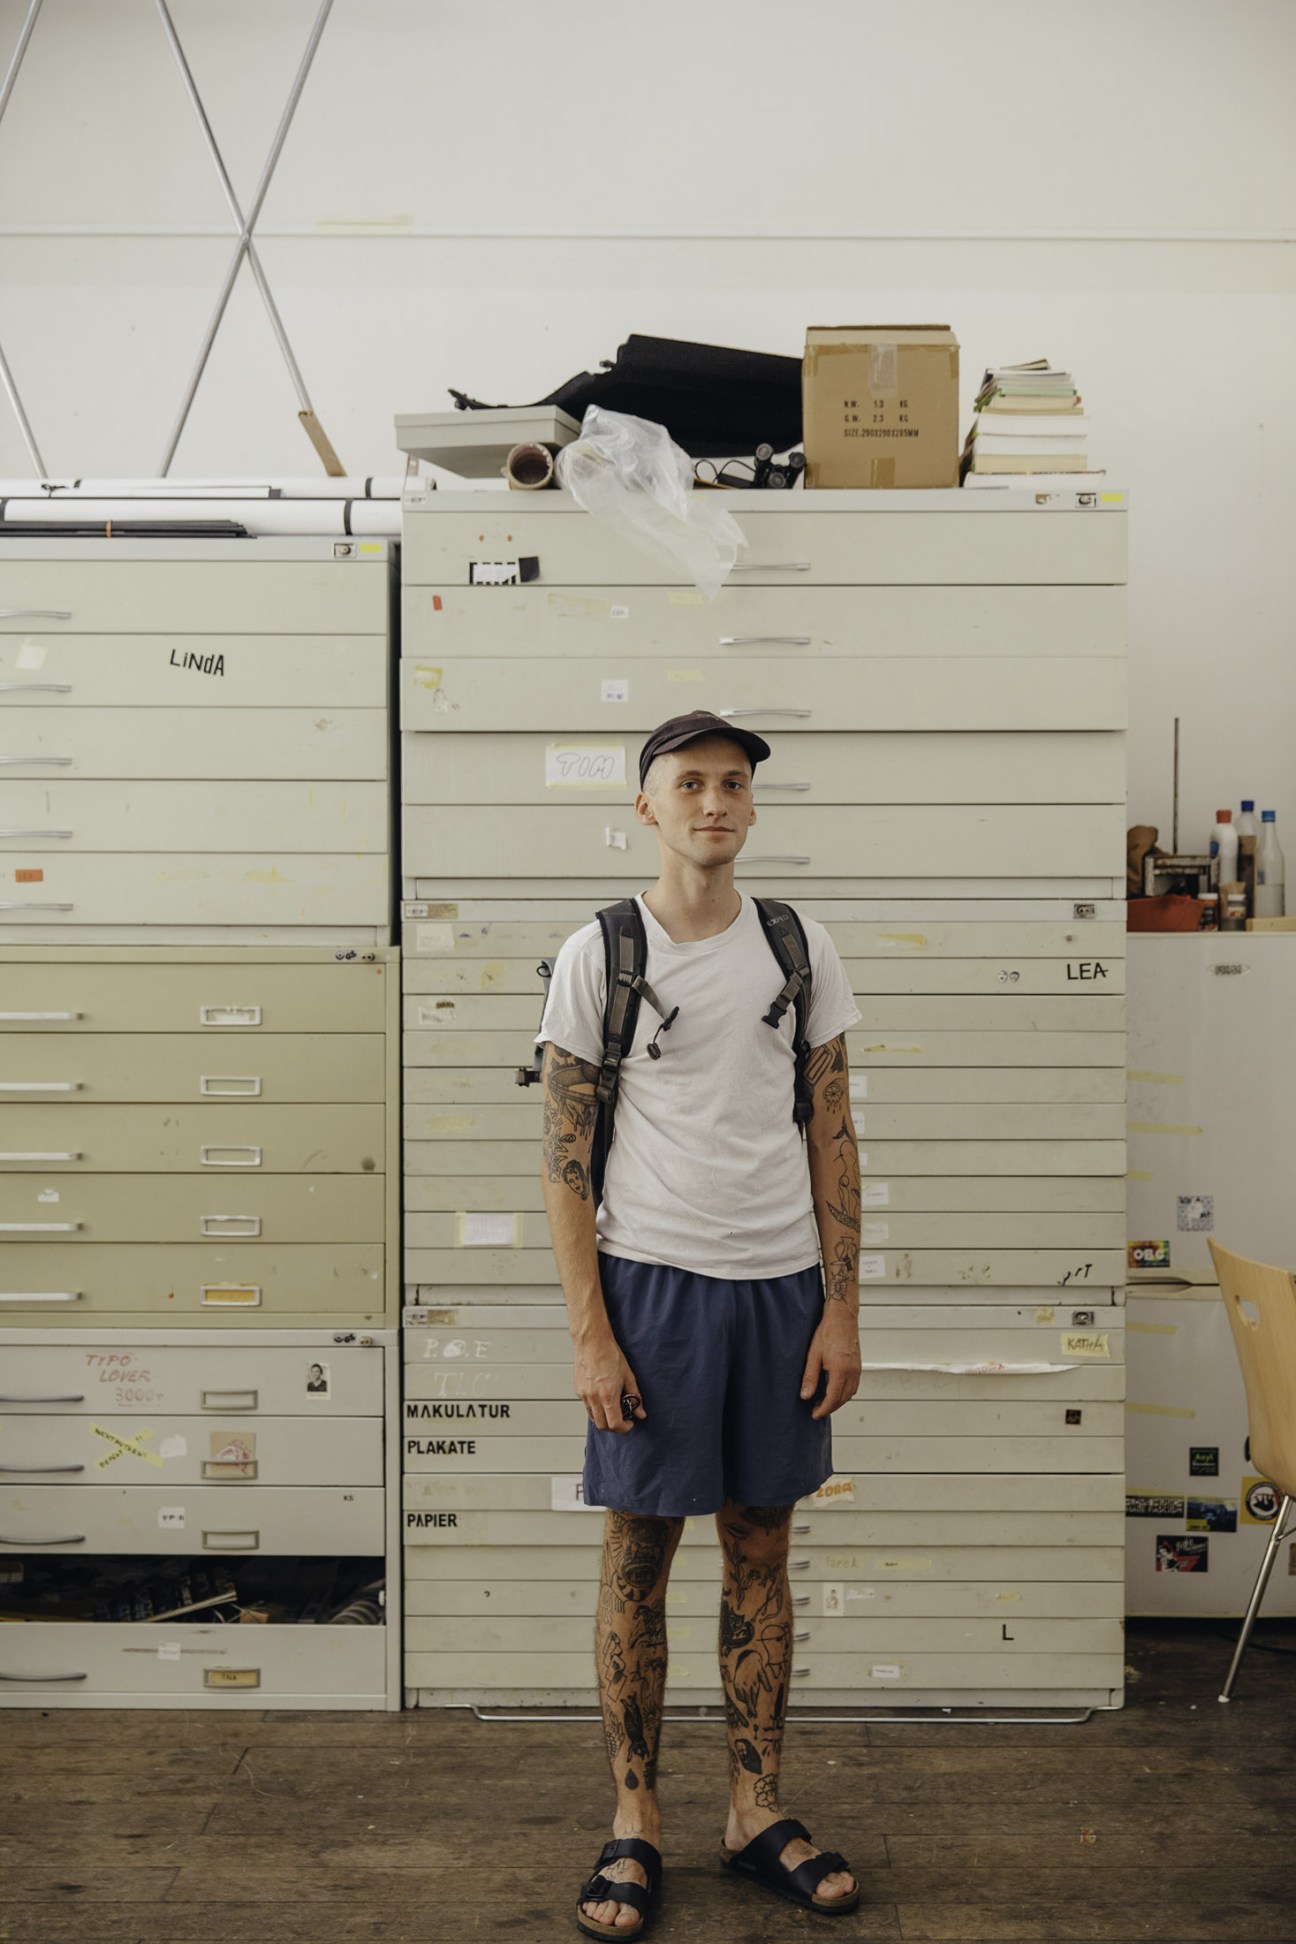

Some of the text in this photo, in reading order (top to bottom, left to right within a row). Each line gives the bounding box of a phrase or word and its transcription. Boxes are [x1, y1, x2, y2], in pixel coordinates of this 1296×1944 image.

[1066, 962, 1109, 981] LEA
[407, 1404, 510, 1418] MAKULATUR
[407, 1441, 476, 1455] PLAKATE
[407, 1513, 457, 1528] PAPIER
[1002, 1624, 1014, 1641] L
